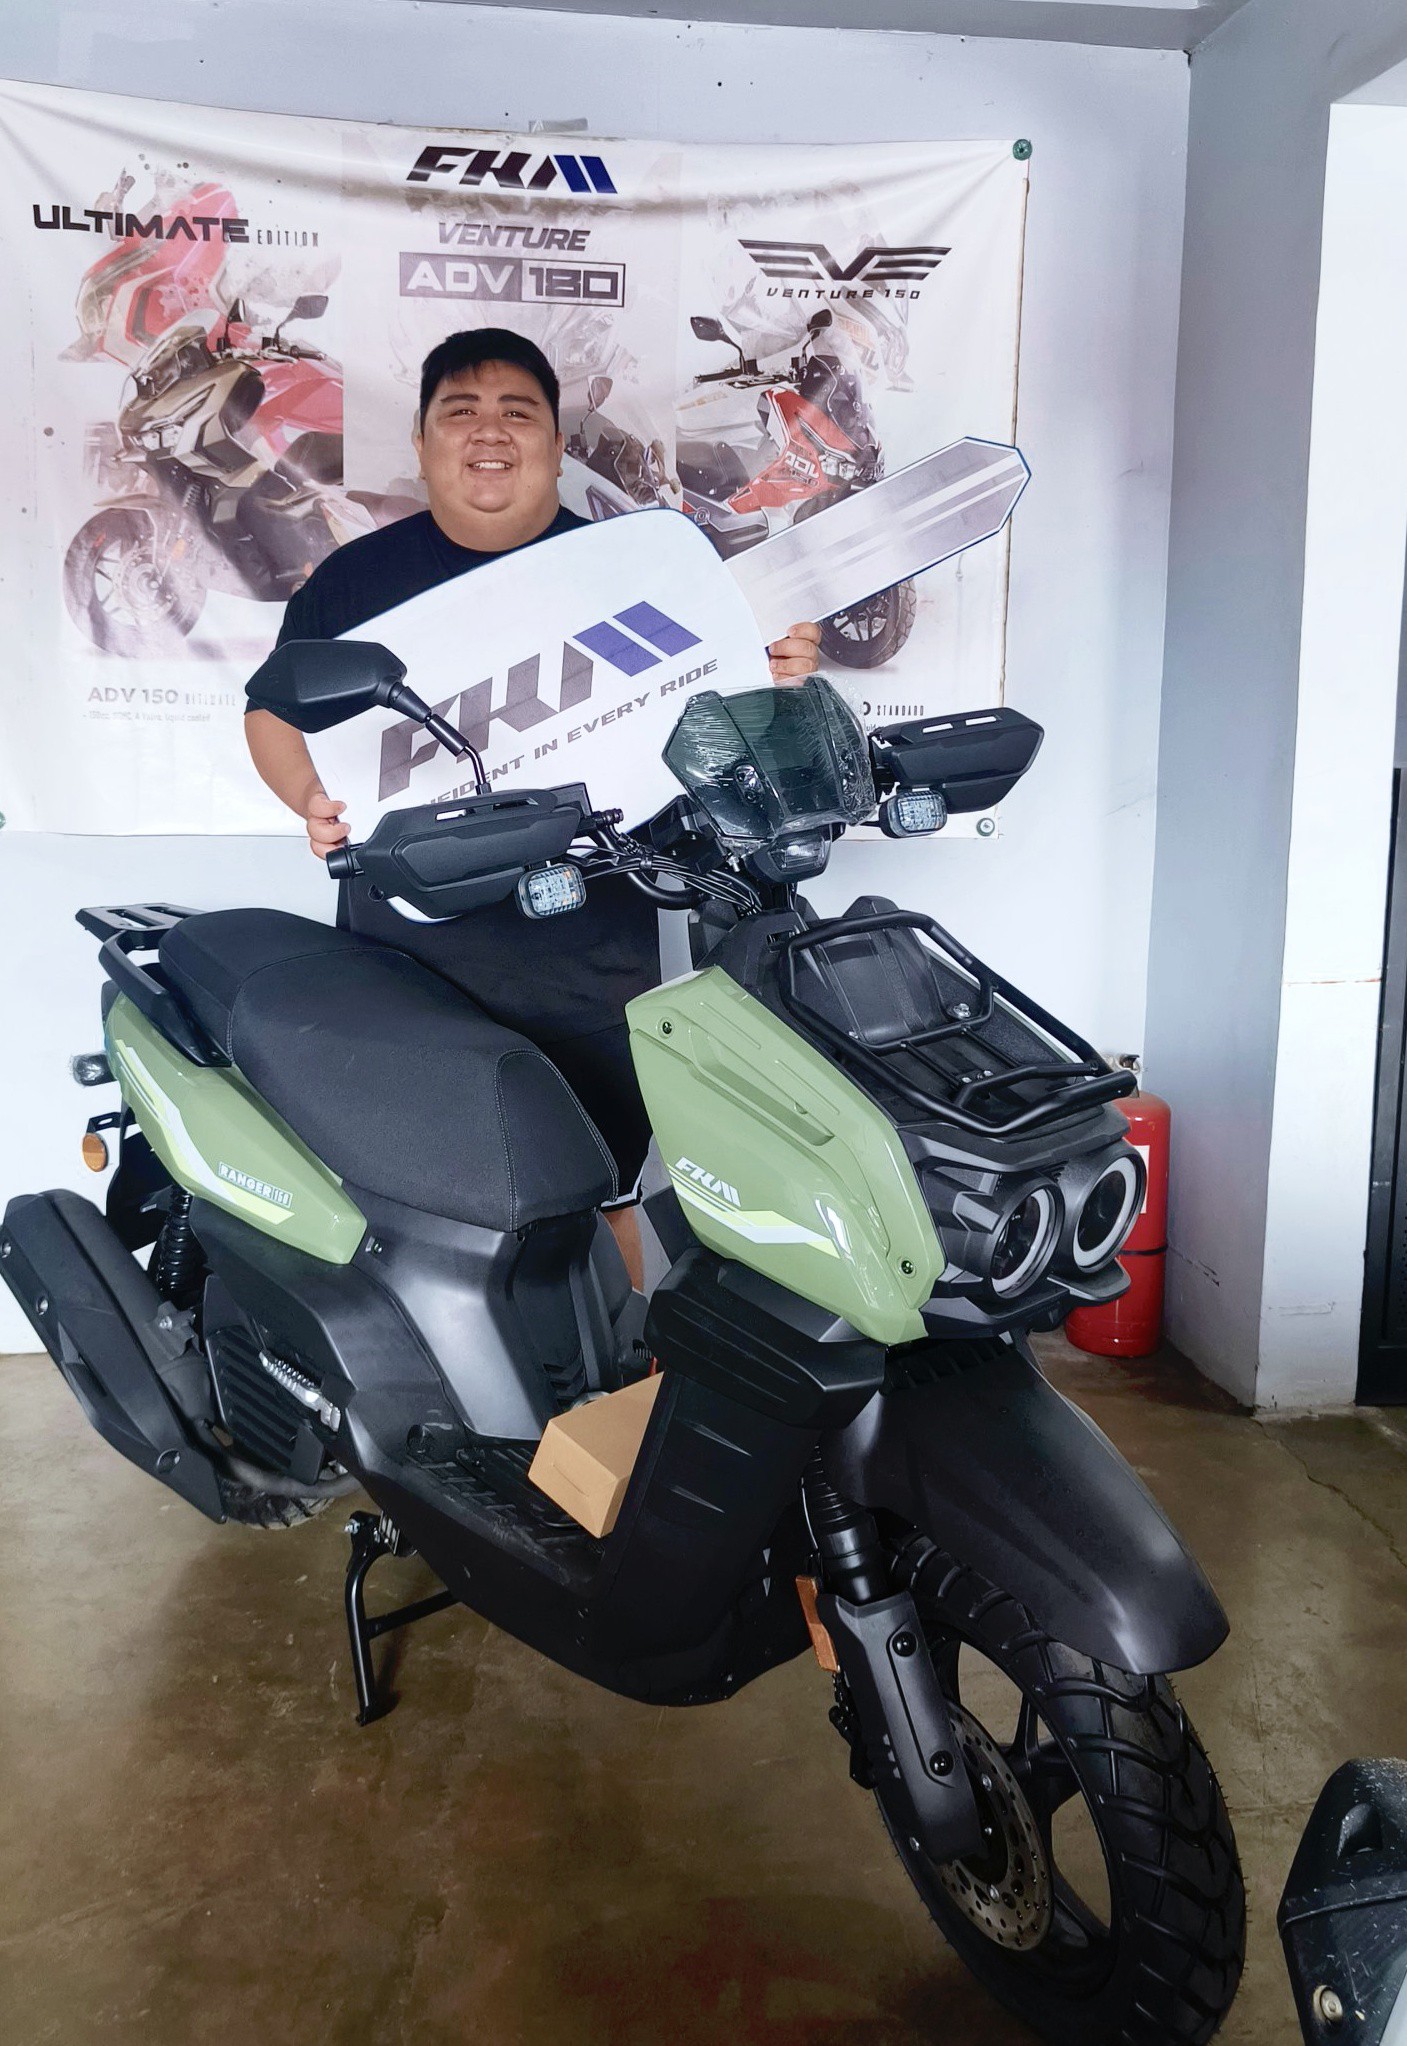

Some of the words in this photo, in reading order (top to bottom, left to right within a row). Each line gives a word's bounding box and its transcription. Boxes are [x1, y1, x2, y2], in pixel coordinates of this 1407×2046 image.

[406, 146, 618, 194] FKM
[32, 204, 250, 243] ULTIMATE
[256, 229, 319, 248] EDITION
[438, 222, 591, 252] VENTURE
[406, 260, 515, 294] ADV
[528, 266, 619, 300] 180
[766, 287, 874, 300] VENTURE
[884, 288, 921, 300] 150
[87, 686, 137, 703] ADV
[142, 688, 180, 705] 150
[378, 601, 703, 802] FKM
[534, 738, 558, 760] IN
[567, 692, 651, 744] EVERY
[660, 658, 718, 698] RIDE
[877, 704, 924, 716] STANDARD
[219, 1163, 273, 1199] RANGER
[273, 1187, 290, 1205] 150
[675, 1156, 742, 1208] FKM
